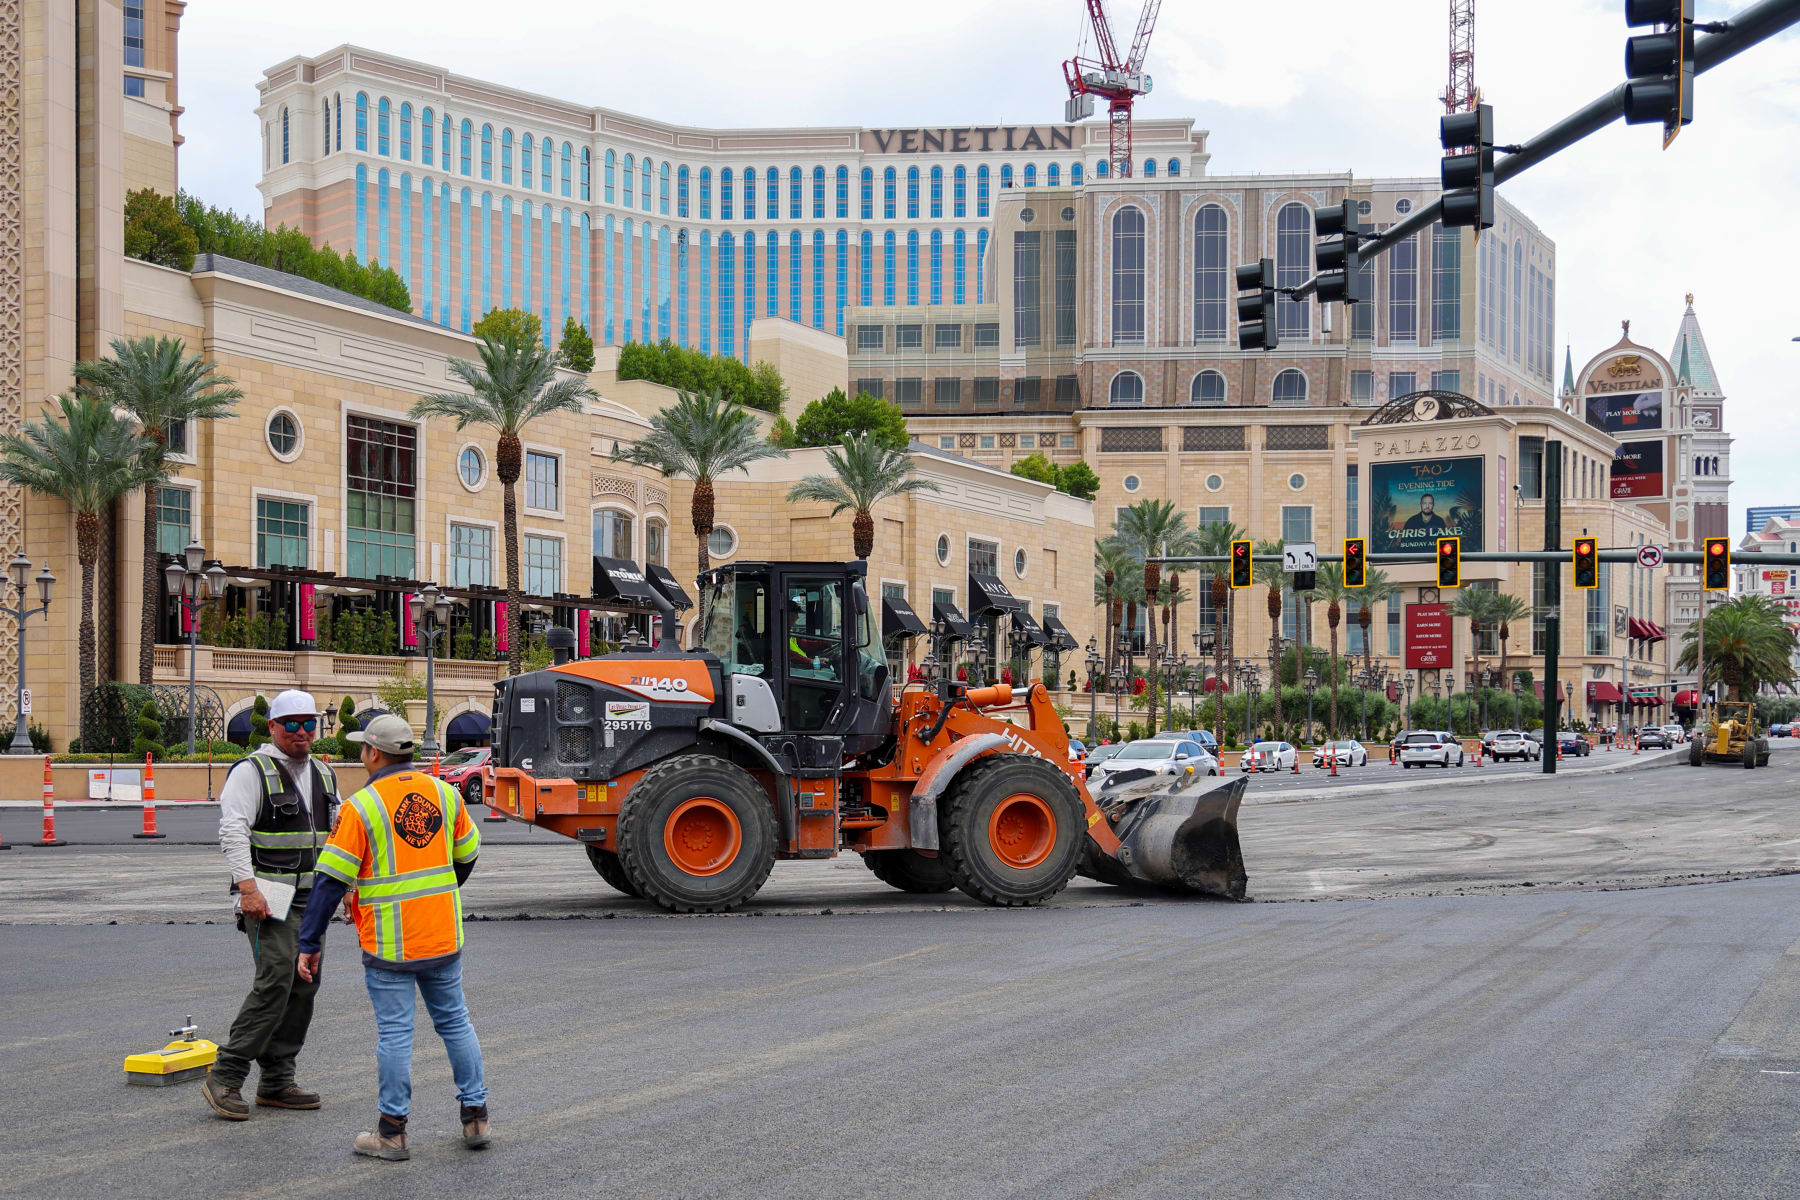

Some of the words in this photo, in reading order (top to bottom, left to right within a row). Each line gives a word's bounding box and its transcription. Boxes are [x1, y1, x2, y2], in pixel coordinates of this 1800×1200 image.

[870, 125, 1076, 154] VENETIAN
[1588, 379, 1661, 393] VENETIAN
[1374, 434, 1480, 455] PALAZZO
[1411, 464, 1442, 476] TAO
[1398, 482, 1435, 490] EVENING
[1437, 479, 1455, 487] TIDE
[1388, 528, 1426, 538] CHRIS
[1430, 527, 1463, 537] LAKE
[607, 569, 645, 582] ATOMIC
[977, 581, 1009, 595] LAVO
[604, 721, 652, 730] 295176
[395, 798, 411, 823] CLARK
[412, 795, 440, 817] COUNTY
[406, 832, 434, 846] NEVADA
